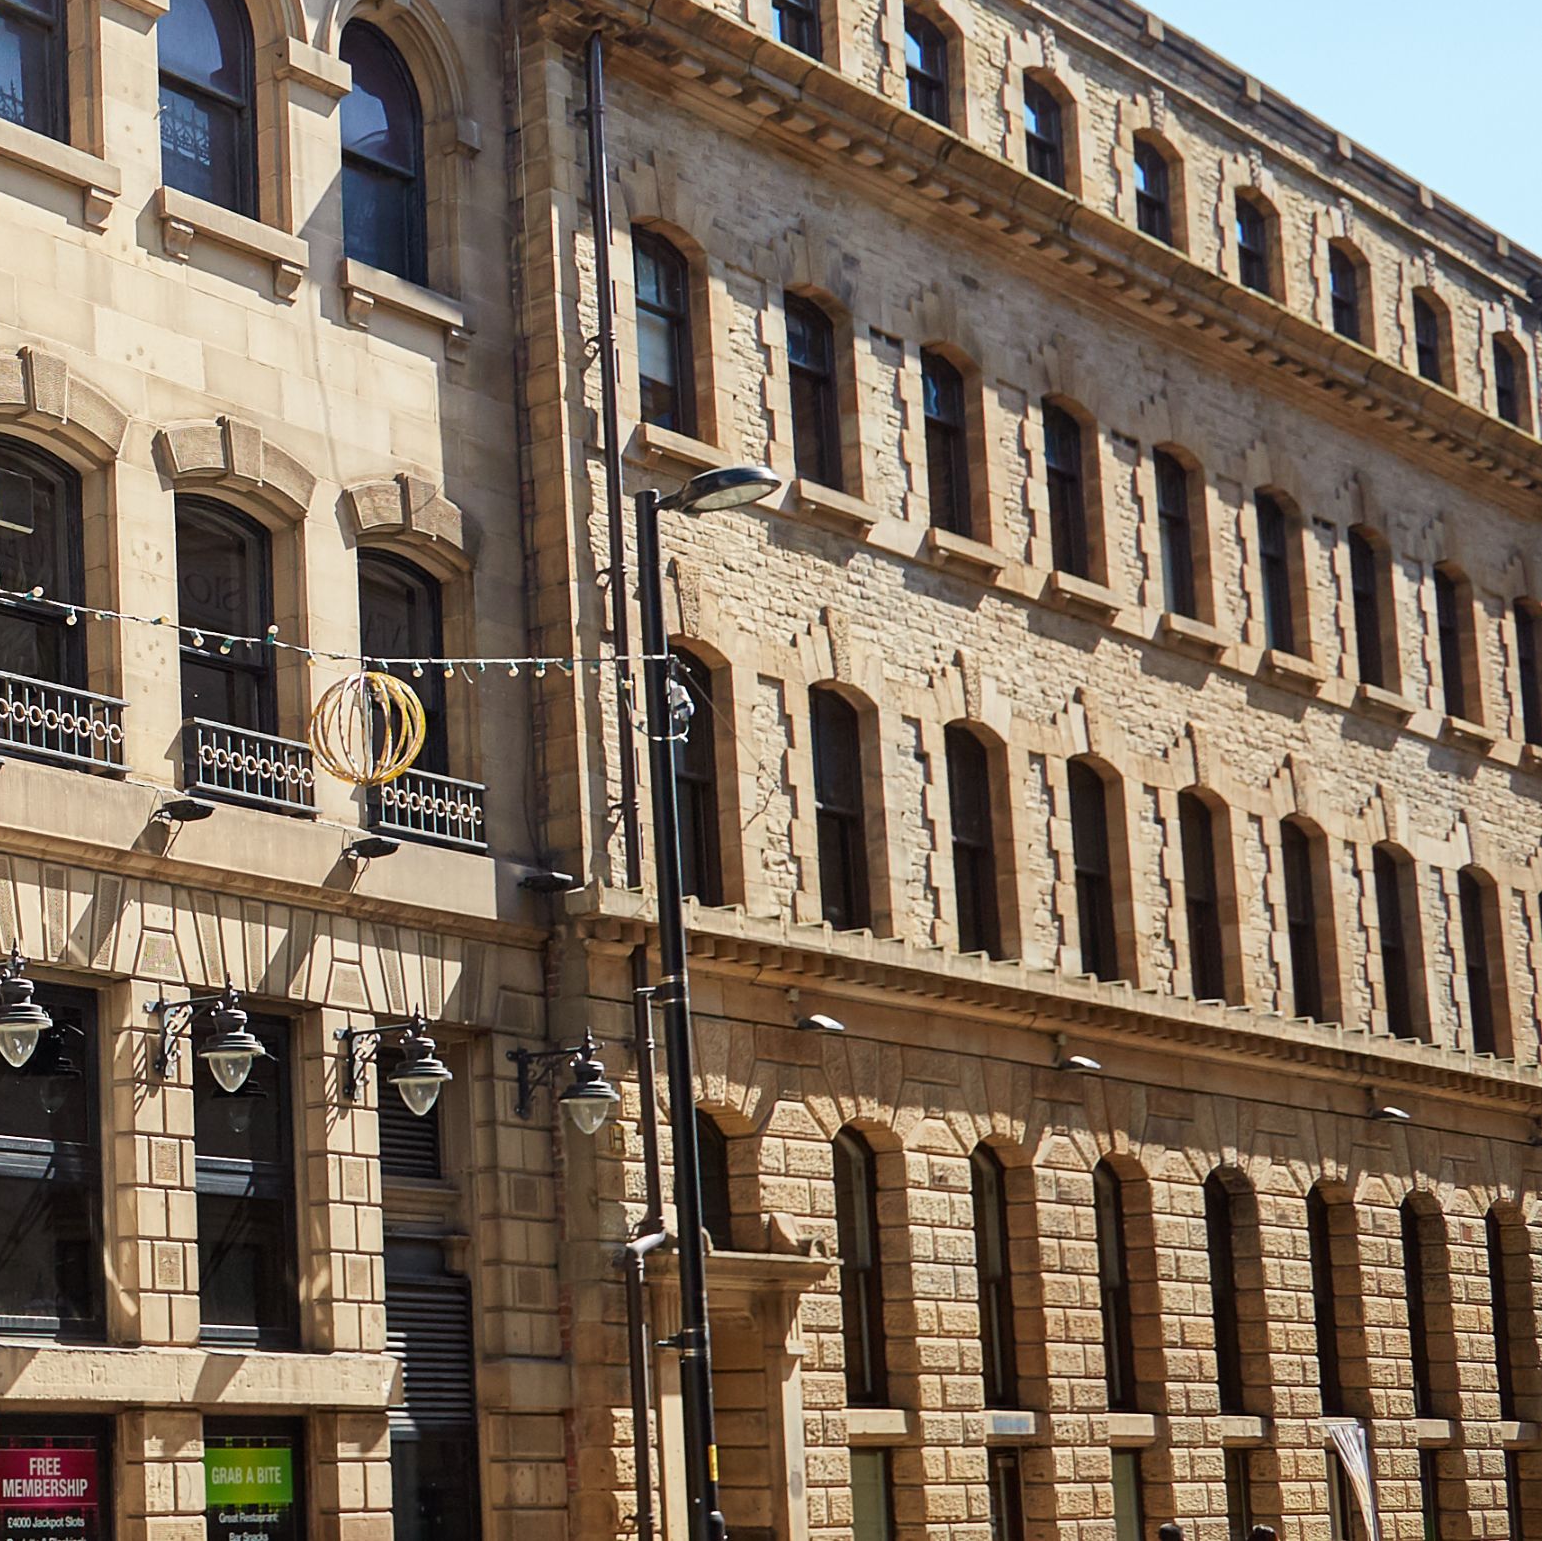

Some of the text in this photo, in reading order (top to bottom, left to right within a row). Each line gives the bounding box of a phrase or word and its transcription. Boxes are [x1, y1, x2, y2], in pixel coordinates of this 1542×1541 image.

[29, 1457, 62, 1476] FREE
[211, 1466, 282, 1485] GRAB A BITE
[2, 1478, 89, 1498] MEMBERSHIP
[7, 1515, 86, 1530] £4000 Jackpot Slots
[218, 1512, 238, 1523] Great
